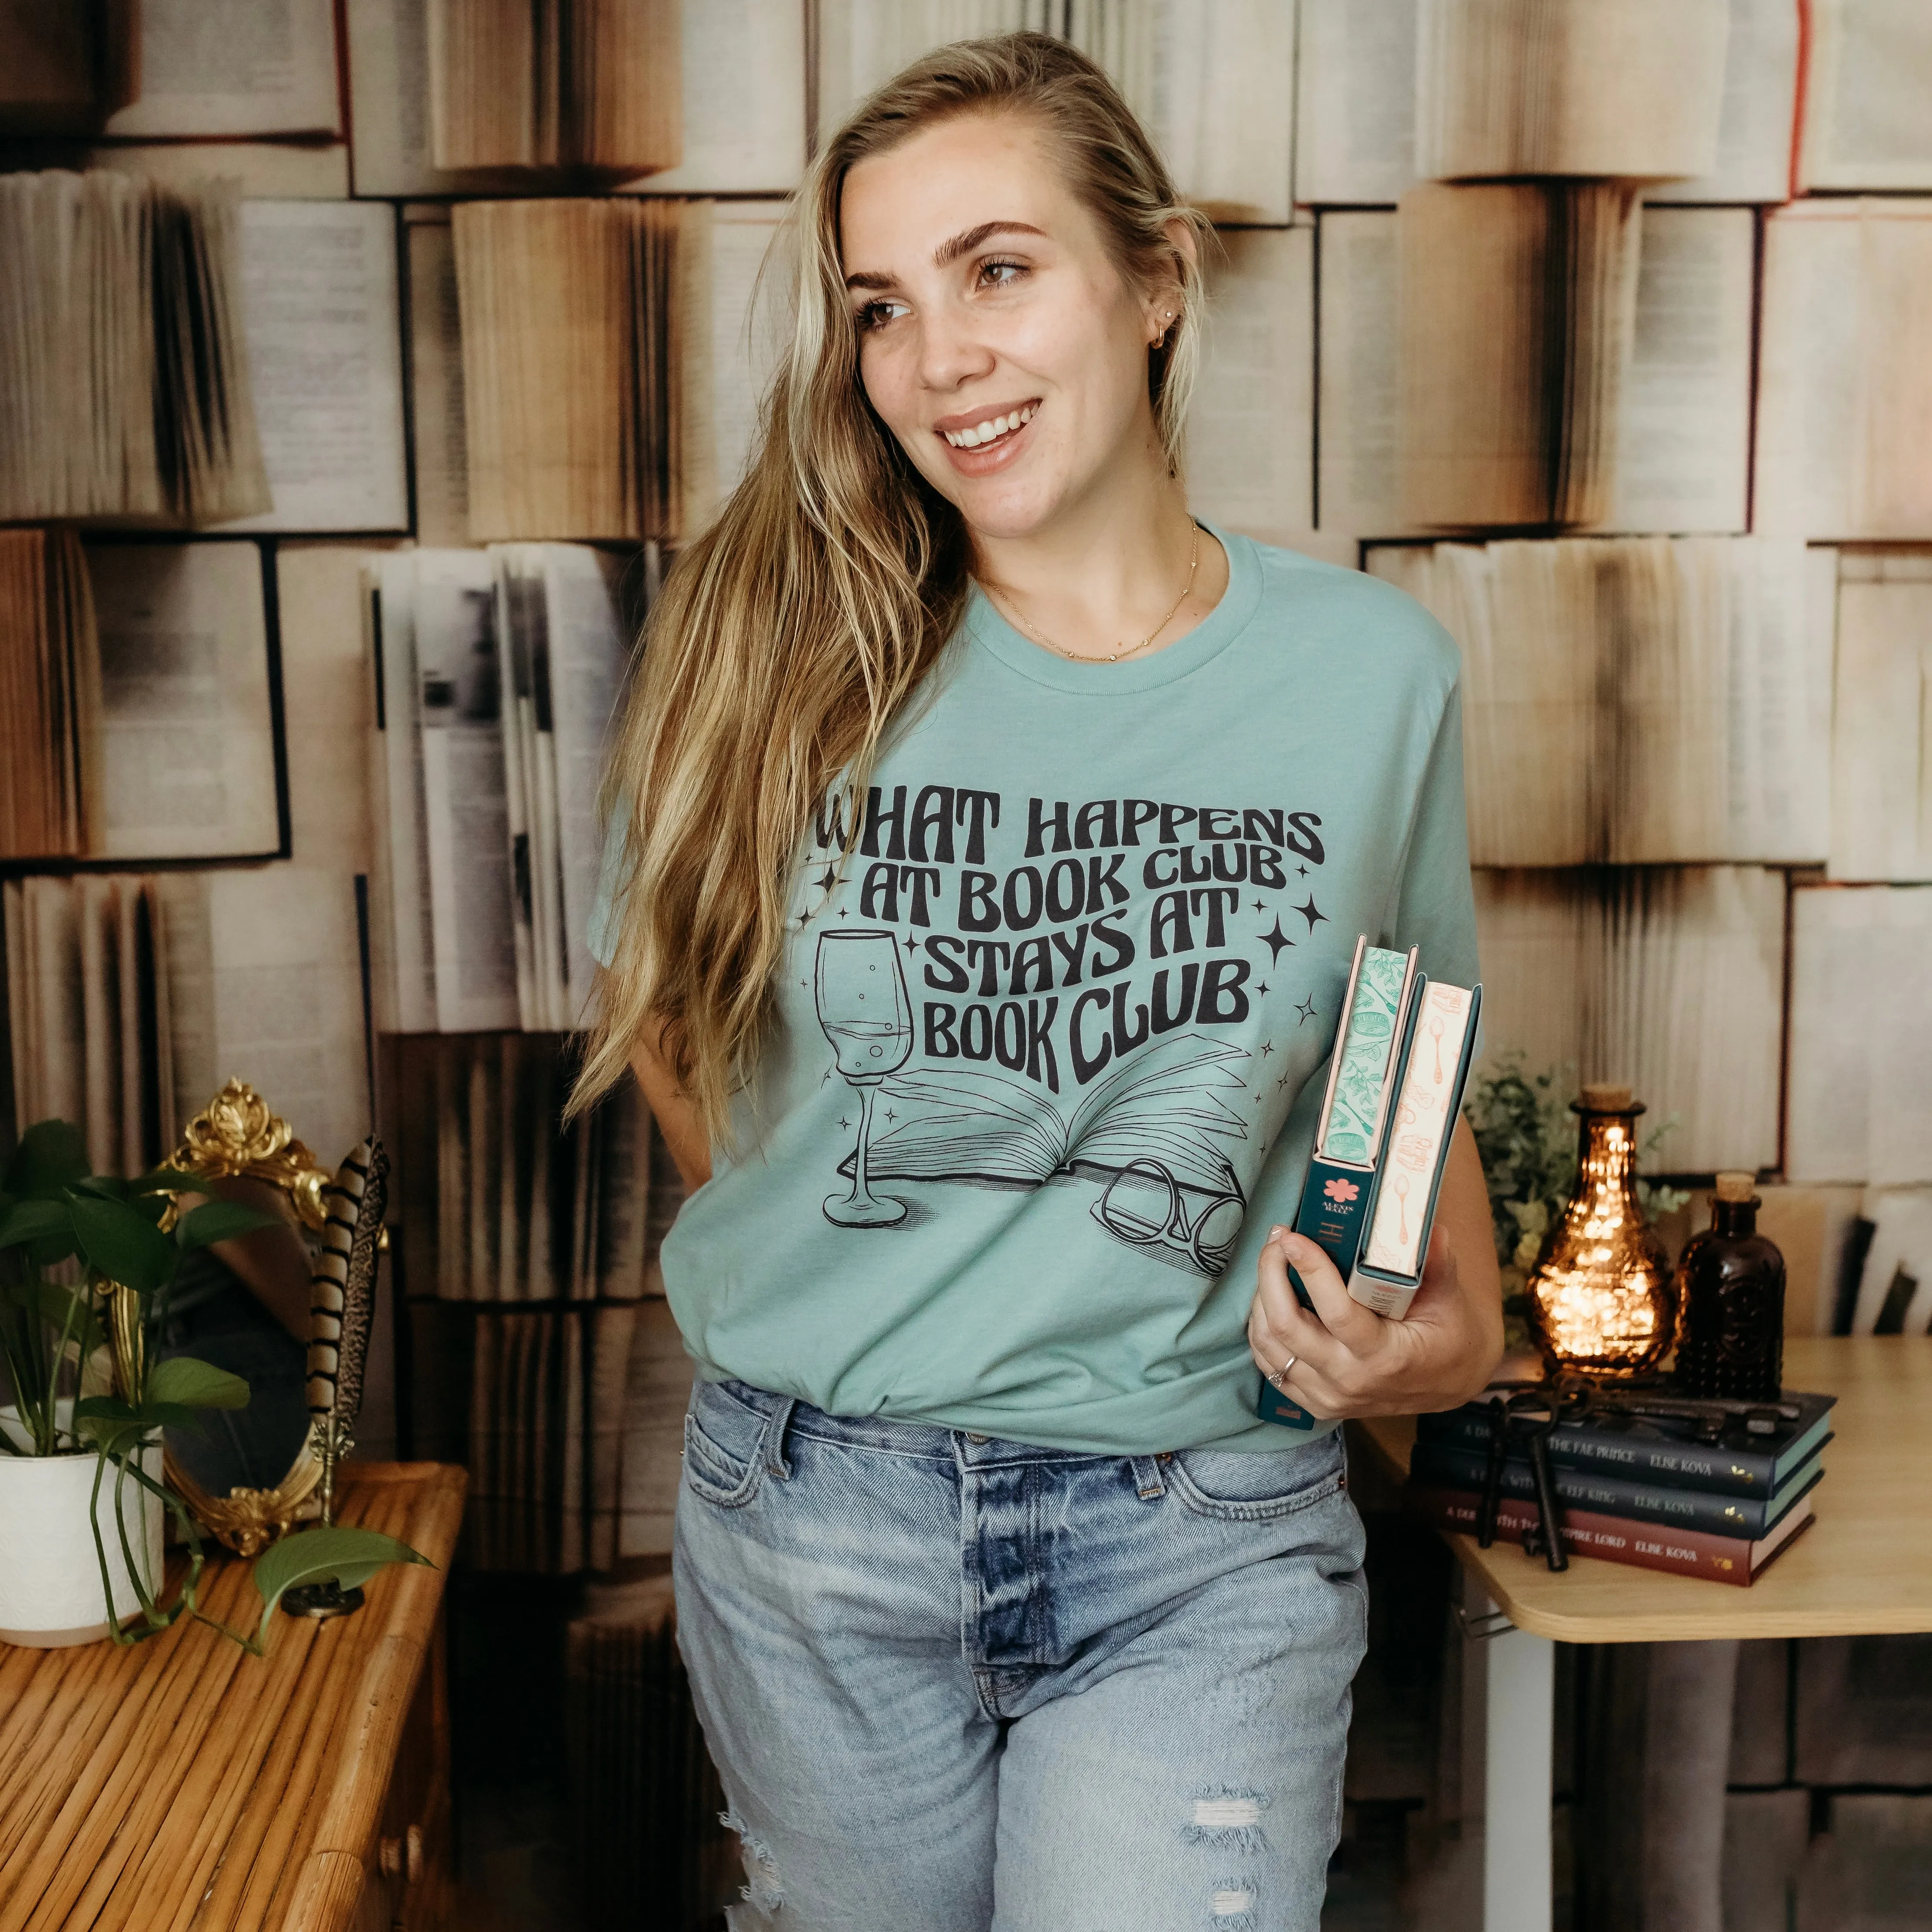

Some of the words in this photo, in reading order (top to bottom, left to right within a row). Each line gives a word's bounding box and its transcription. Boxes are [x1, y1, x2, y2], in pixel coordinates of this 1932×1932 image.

[816, 784, 1000, 865] WHAT
[1024, 798, 1325, 865] HAPPENS
[860, 862, 941, 928] AT
[958, 854, 1130, 933] BOOK
[1143, 843, 1287, 890] CLUB
[924, 909, 1135, 997] STAYS
[1151, 888, 1239, 959] AT
[924, 997, 1059, 1095] BOOK
[1070, 959, 1251, 1085] CLUB
[1664, 1500, 1695, 1516] KOVA
[1681, 1460, 1712, 1477] KOVA
[1594, 1532, 1626, 1549] LORD
[1665, 1546, 1698, 1562] KOVA
